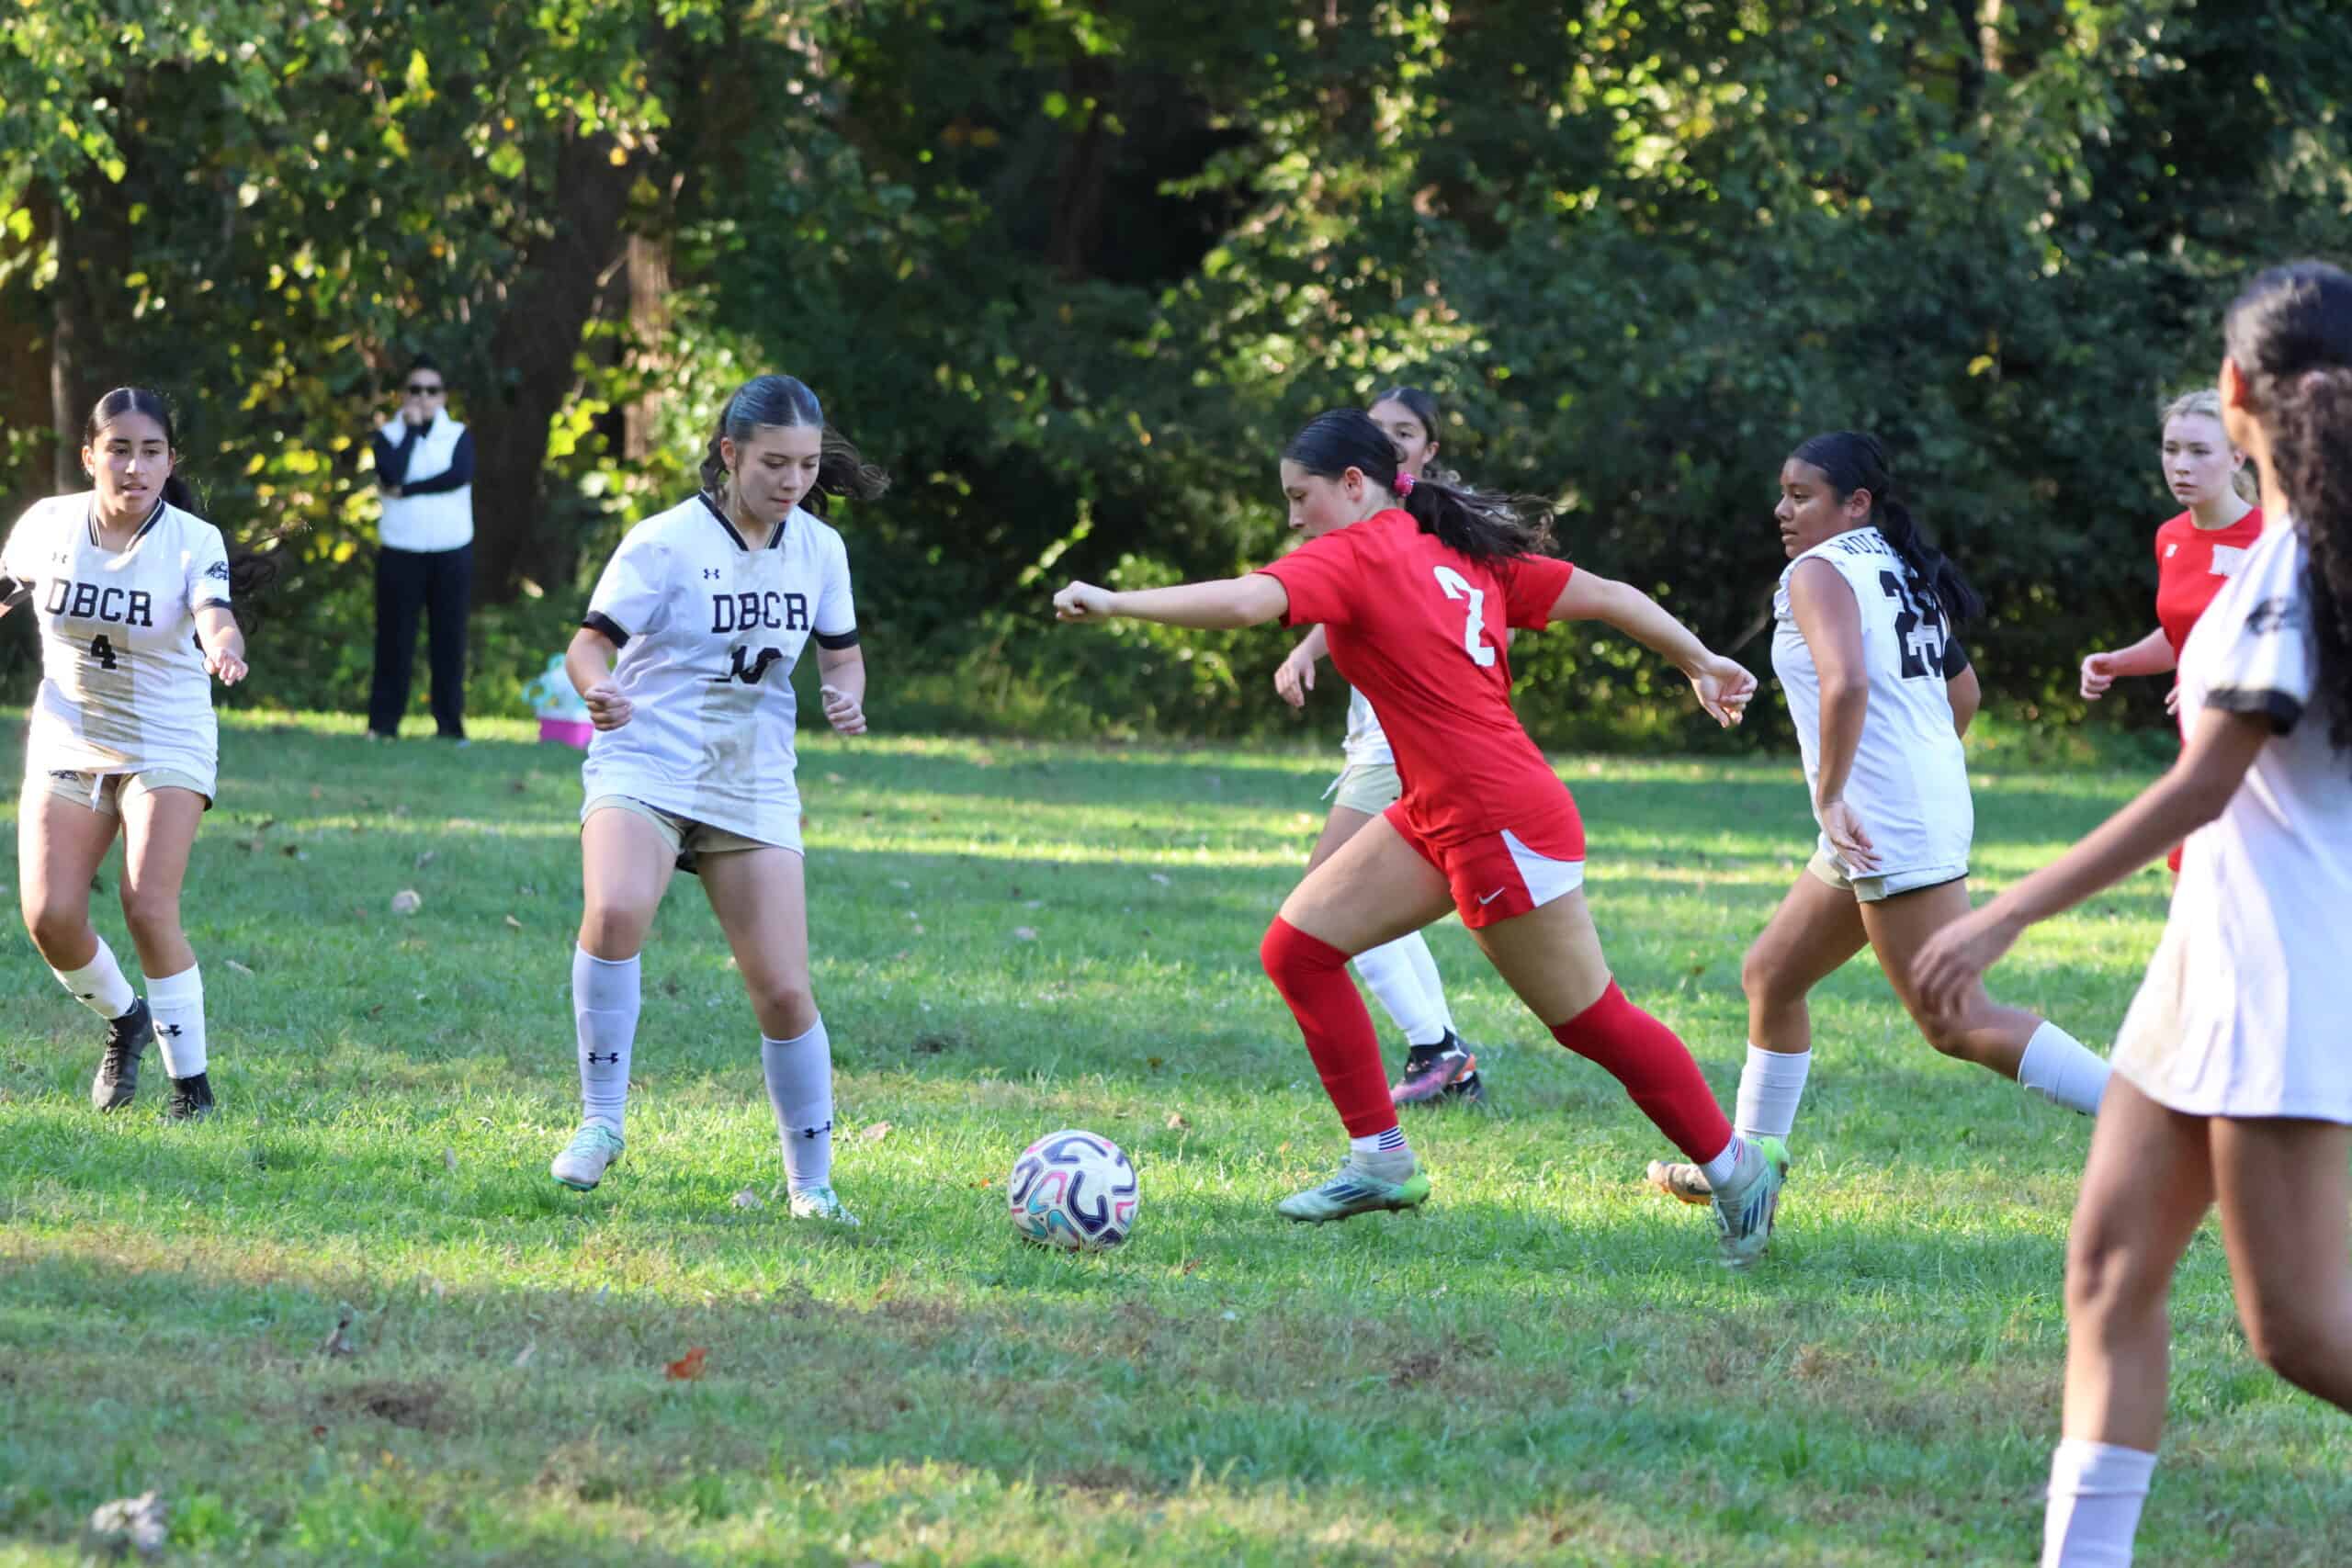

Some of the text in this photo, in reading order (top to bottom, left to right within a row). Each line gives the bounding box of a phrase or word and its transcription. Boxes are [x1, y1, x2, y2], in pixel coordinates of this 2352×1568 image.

[45, 579, 153, 626] DBCR
[711, 592, 809, 634] DBCR
[1433, 565, 1496, 667] 2
[90, 634, 117, 670] 4
